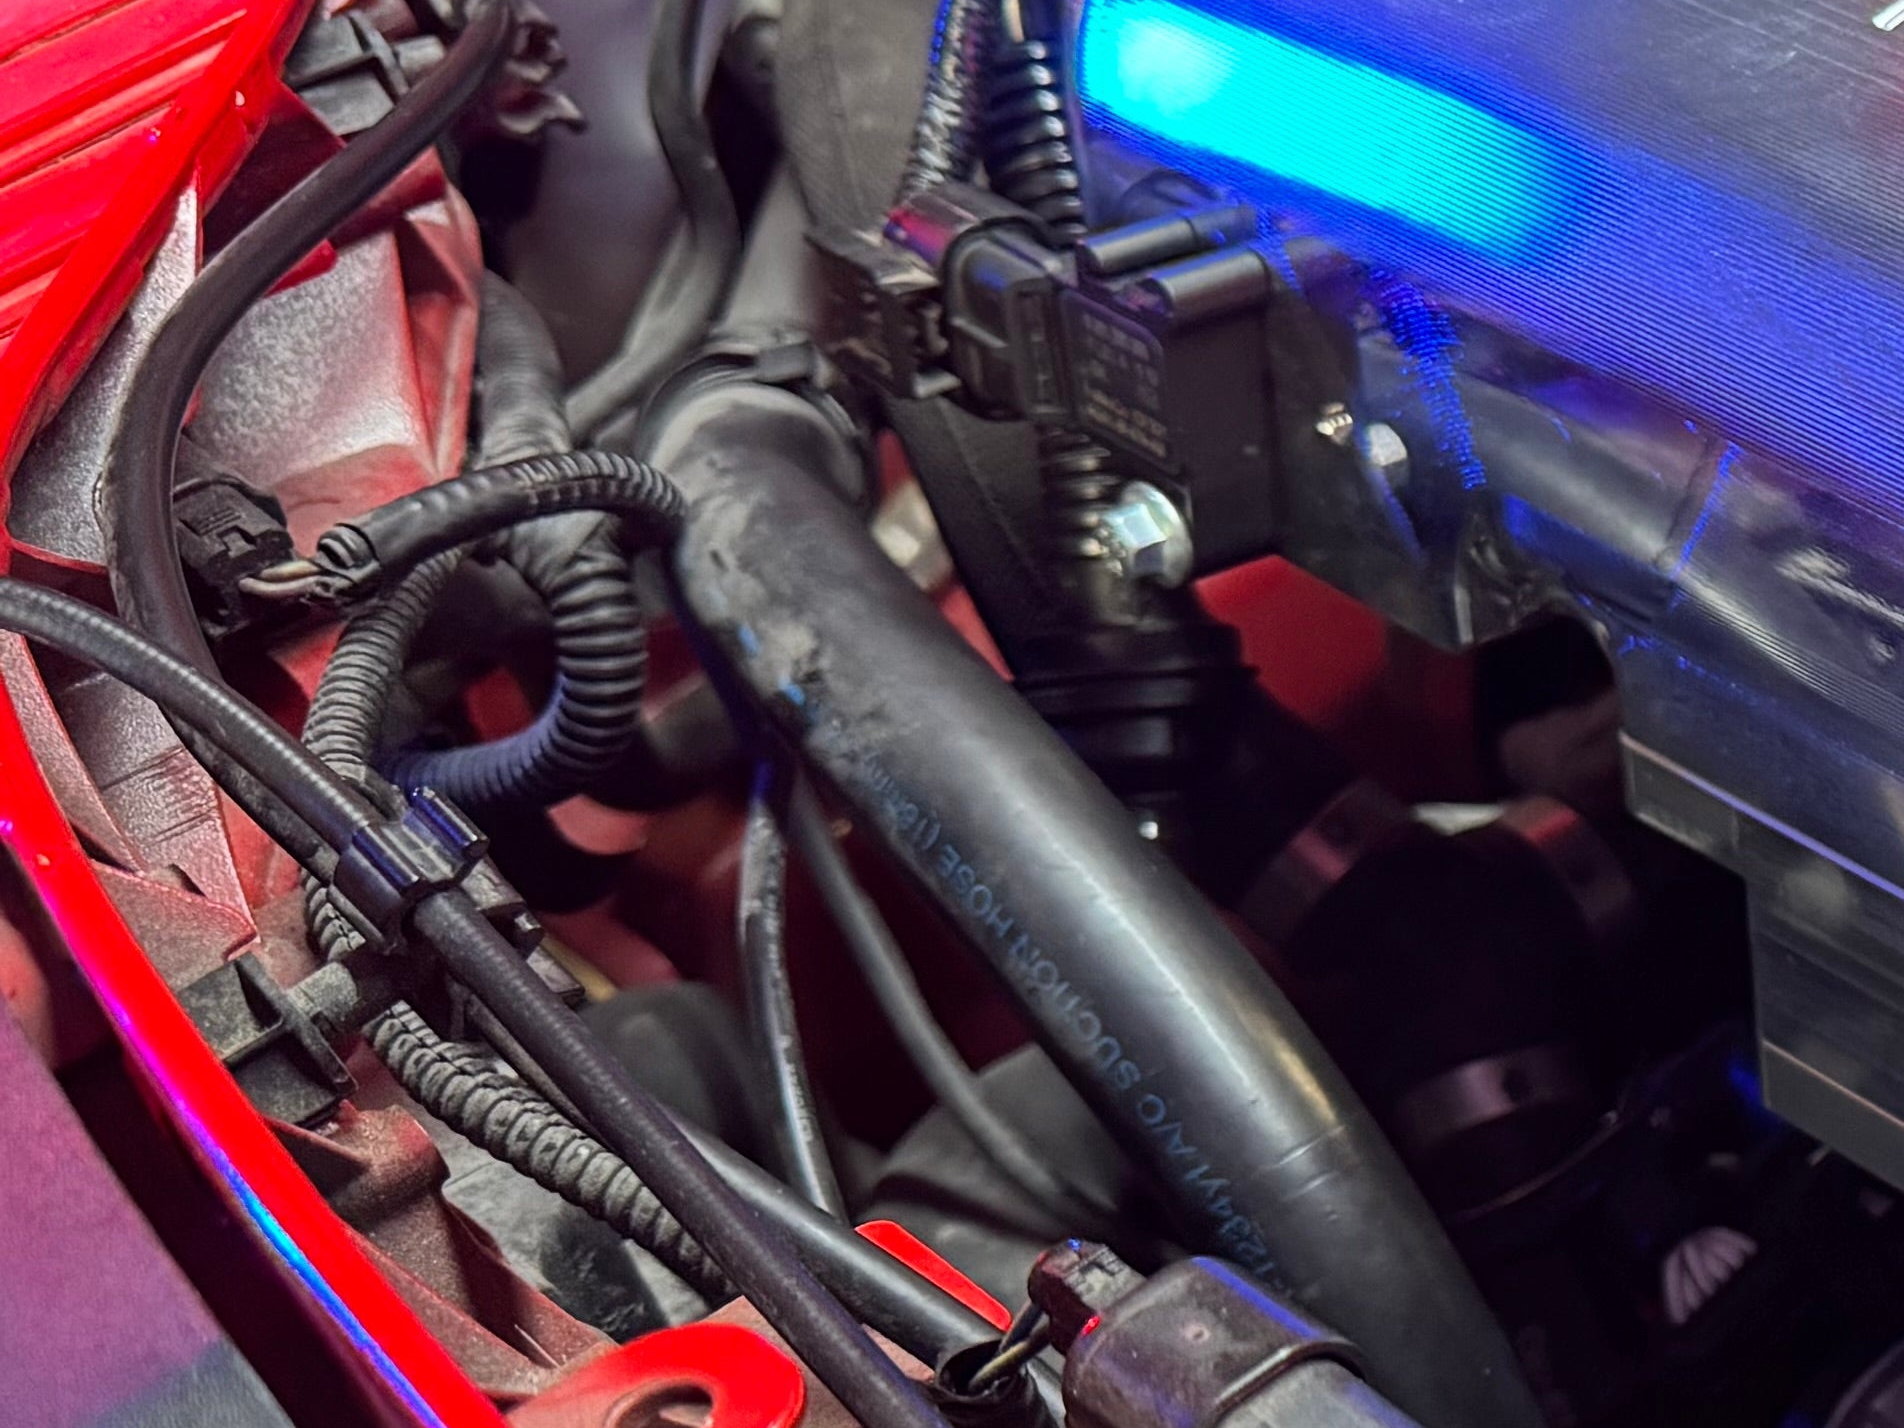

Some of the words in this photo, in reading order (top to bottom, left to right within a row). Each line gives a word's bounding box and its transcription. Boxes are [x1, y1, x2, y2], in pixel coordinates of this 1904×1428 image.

[937, 838, 1015, 938] HOSE
[1010, 936, 1142, 1092] SUCTION
[1136, 1092, 1197, 1159] A/C
